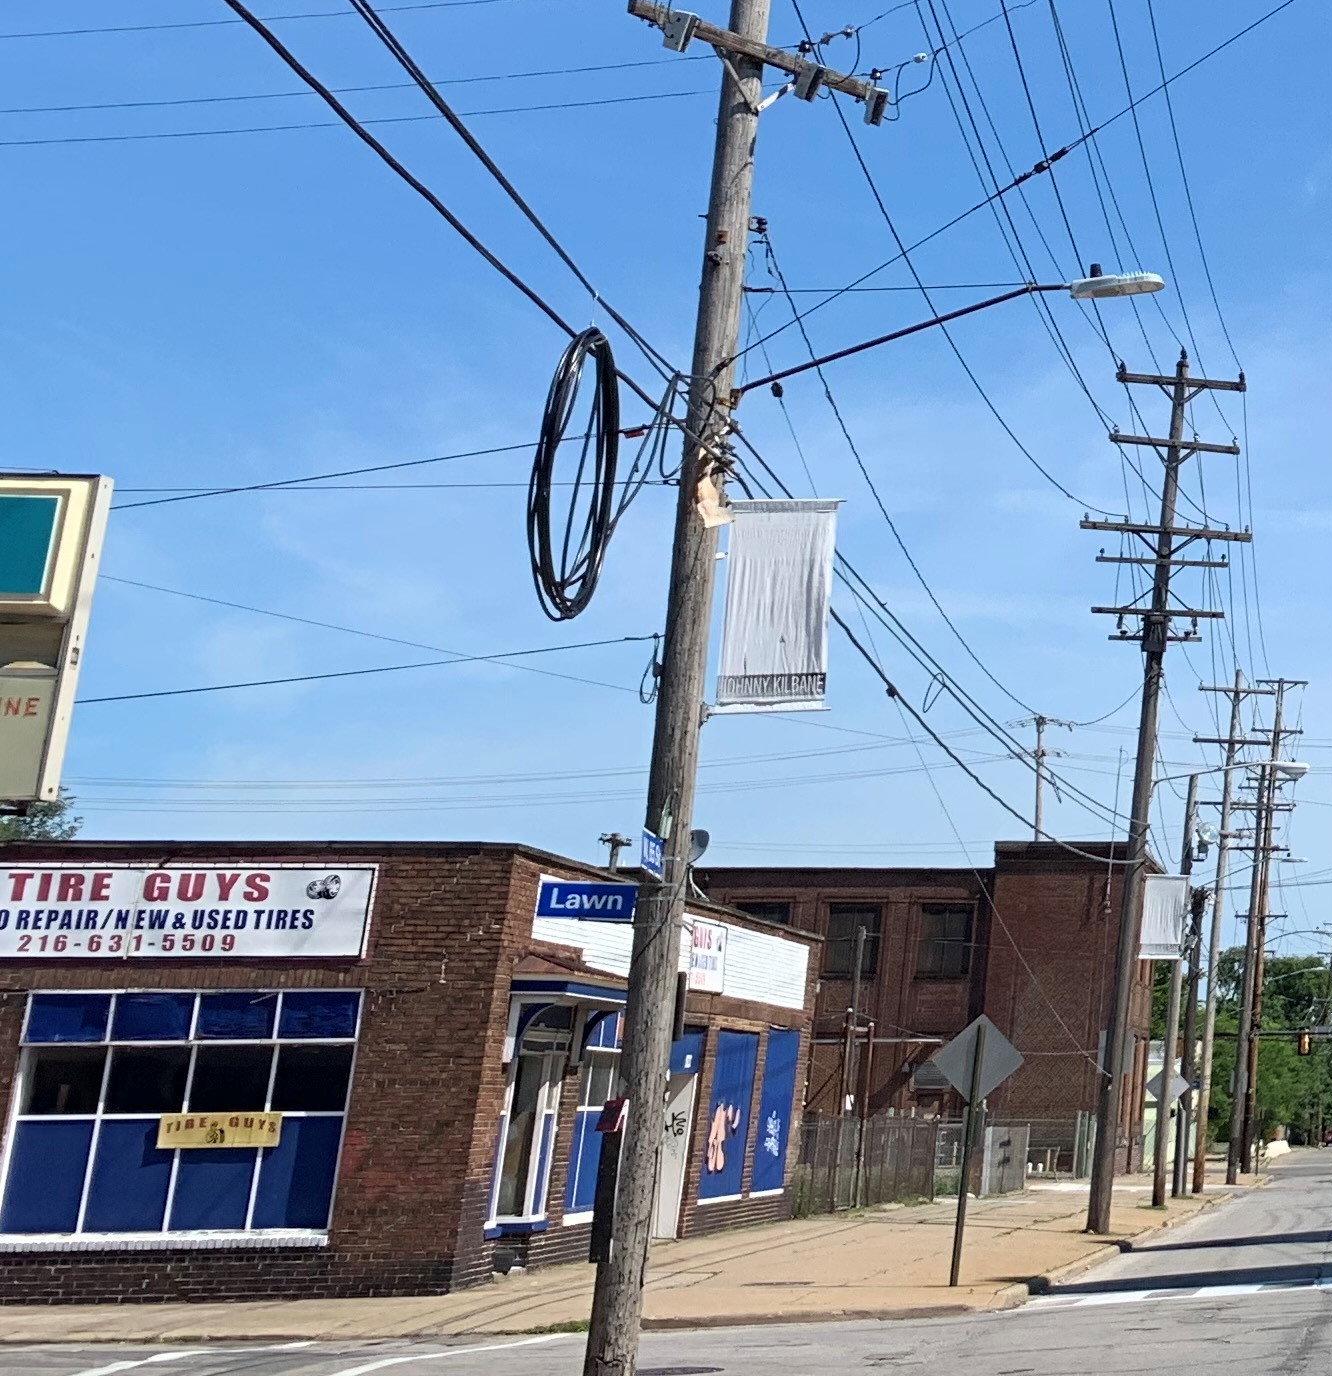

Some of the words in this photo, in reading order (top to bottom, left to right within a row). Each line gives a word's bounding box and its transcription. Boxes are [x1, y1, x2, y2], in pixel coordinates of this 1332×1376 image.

[773, 674, 825, 695] KILBANE
[8, 872, 113, 902] TIRE
[142, 872, 271, 903] GUYS
[549, 887, 623, 911] Lawn
[191, 909, 249, 930] USED
[253, 909, 315, 930] TIRES
[16, 933, 236, 953] 216-631-5509
[165, 1117, 208, 1134] TIRE
[228, 1116, 277, 1133] GUYS
